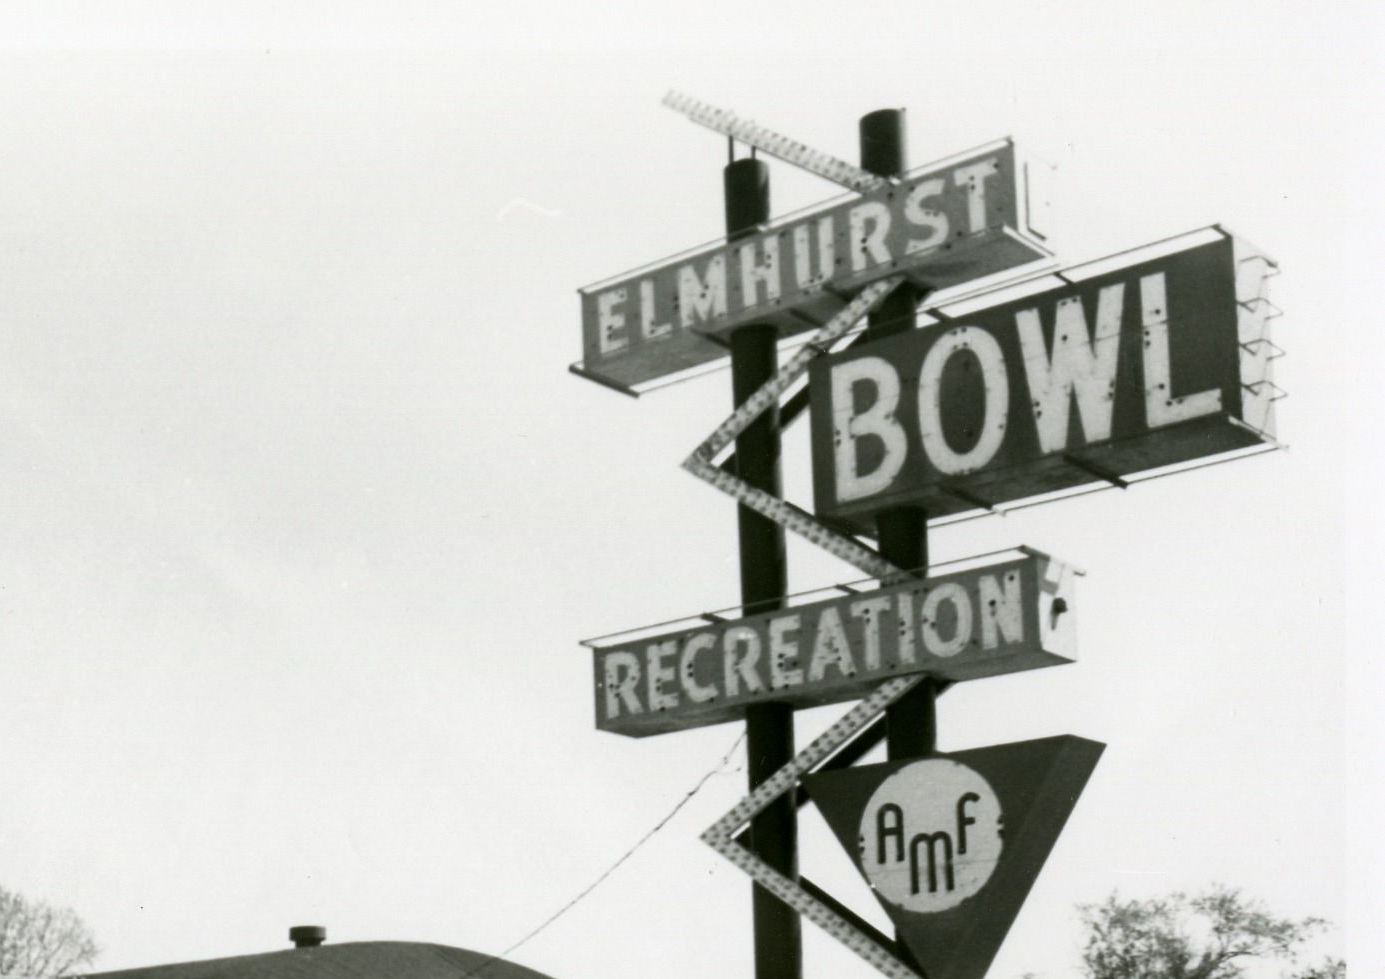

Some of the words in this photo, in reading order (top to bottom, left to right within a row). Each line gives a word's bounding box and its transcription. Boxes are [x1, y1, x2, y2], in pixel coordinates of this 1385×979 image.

[597, 157, 999, 355] ELMHURST
[828, 270, 1222, 502] BOWL
[603, 569, 1025, 720] RECREATION
[875, 791, 982, 895] AMF
